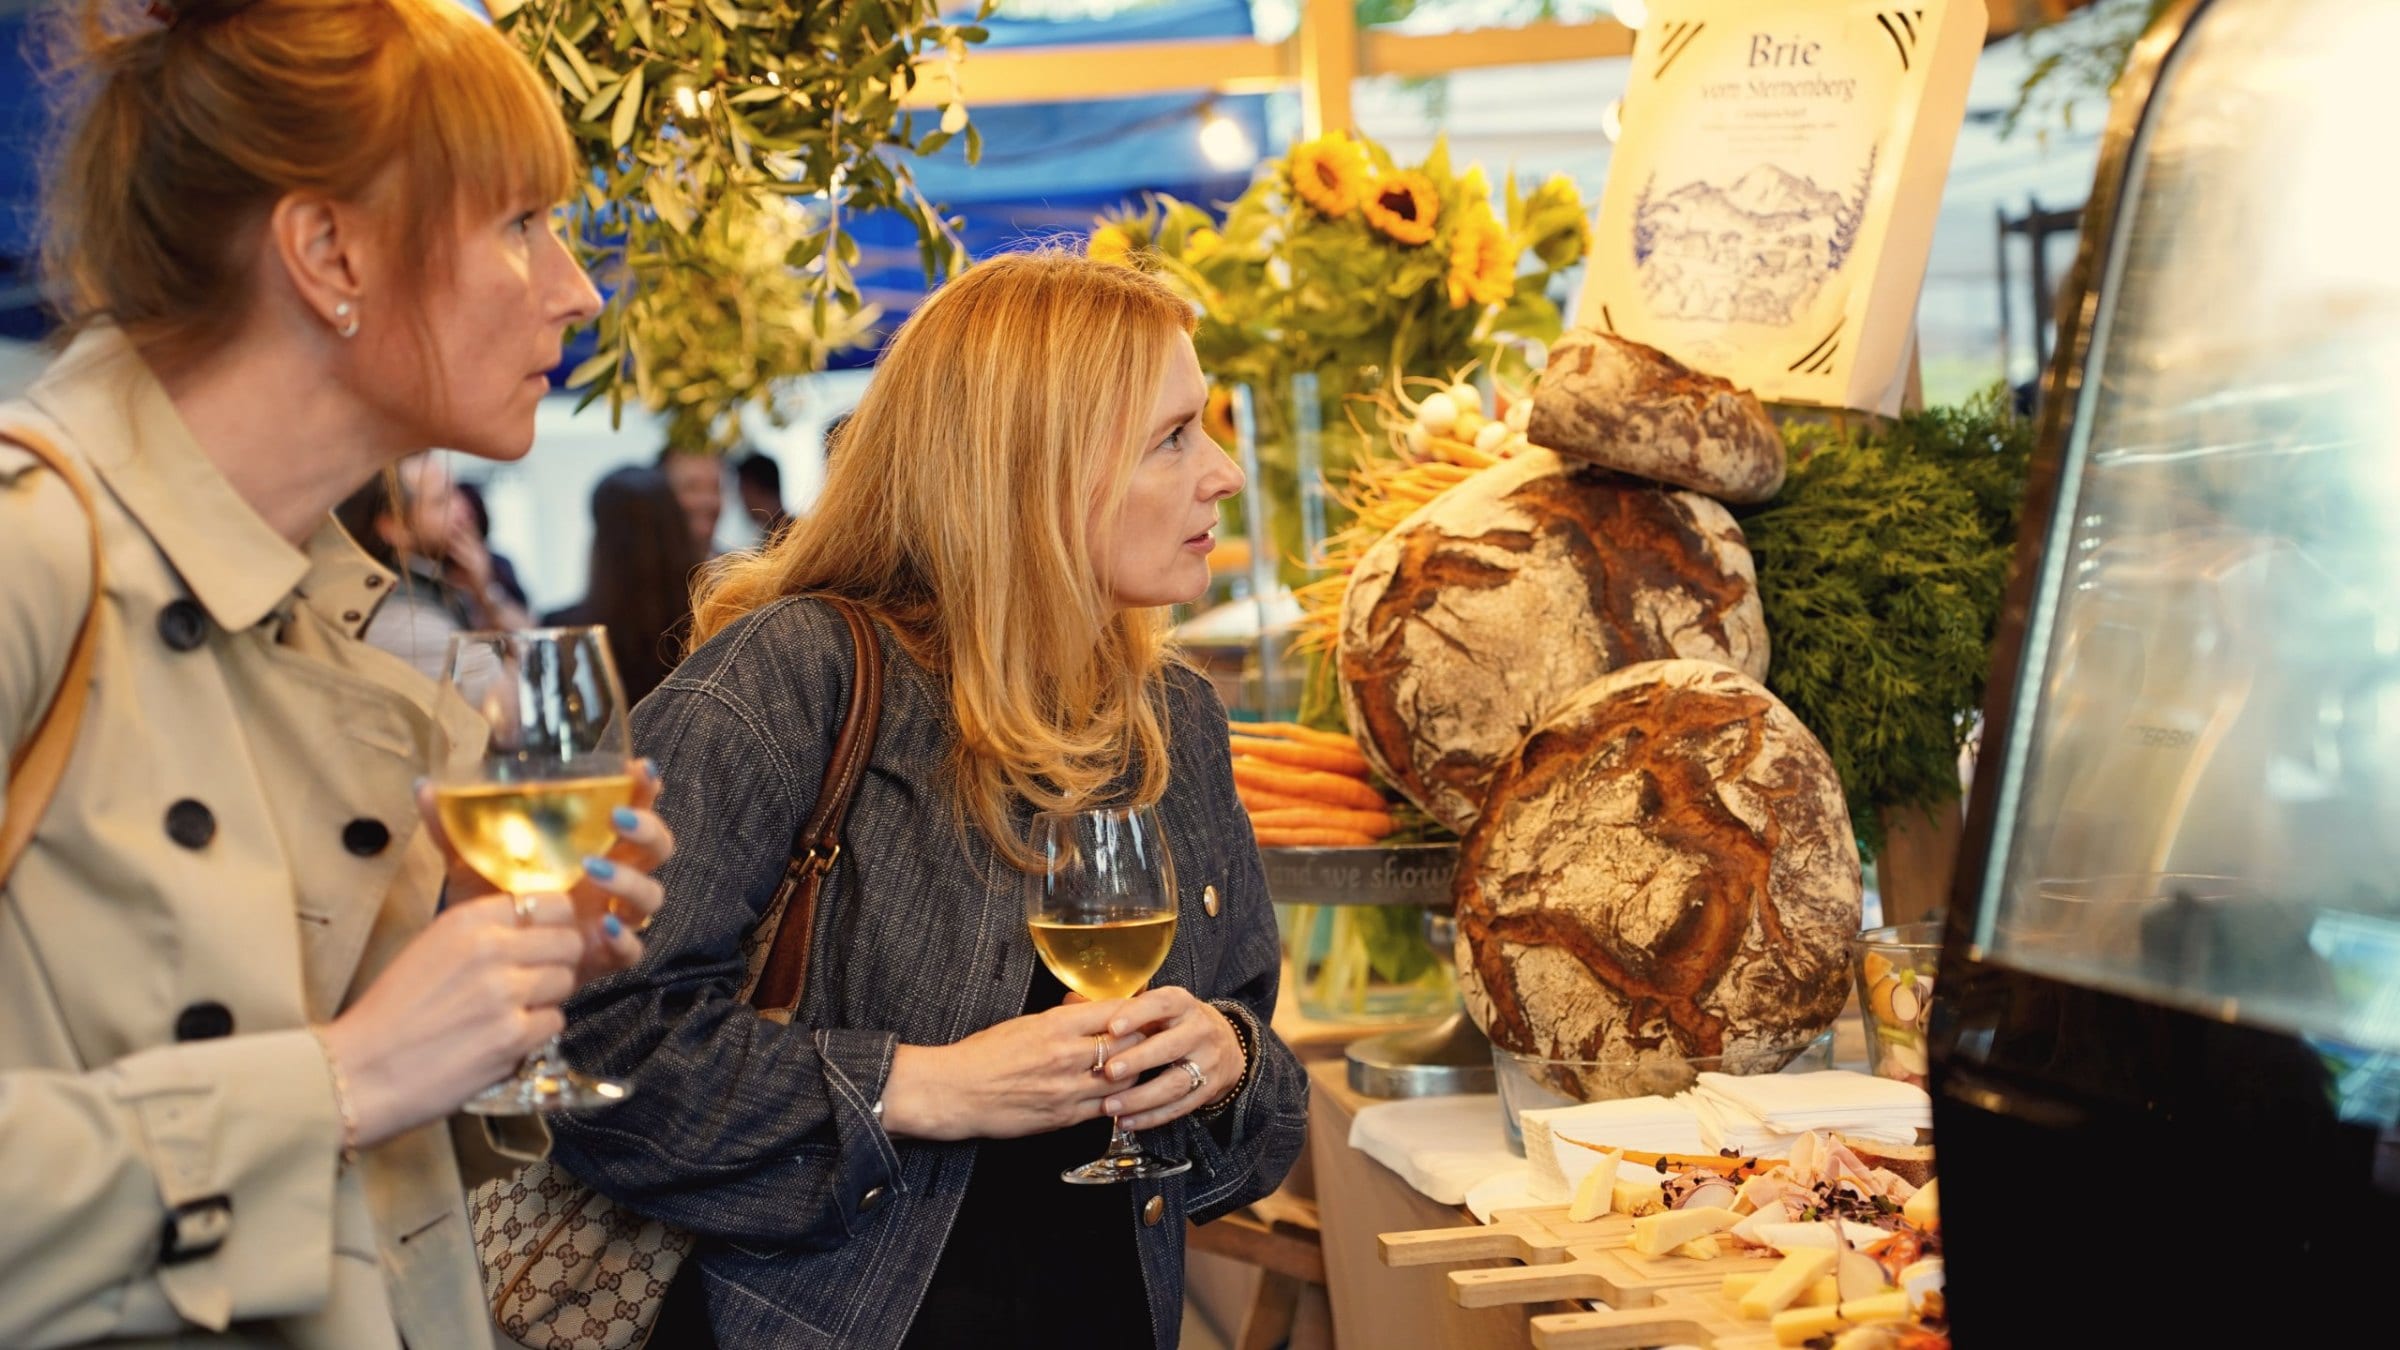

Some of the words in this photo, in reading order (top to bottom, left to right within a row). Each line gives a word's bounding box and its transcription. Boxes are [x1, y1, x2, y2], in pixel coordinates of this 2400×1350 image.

[1748, 32, 1822, 68] Brie
[1321, 865, 1361, 888] we
[1371, 855, 1449, 889] show
